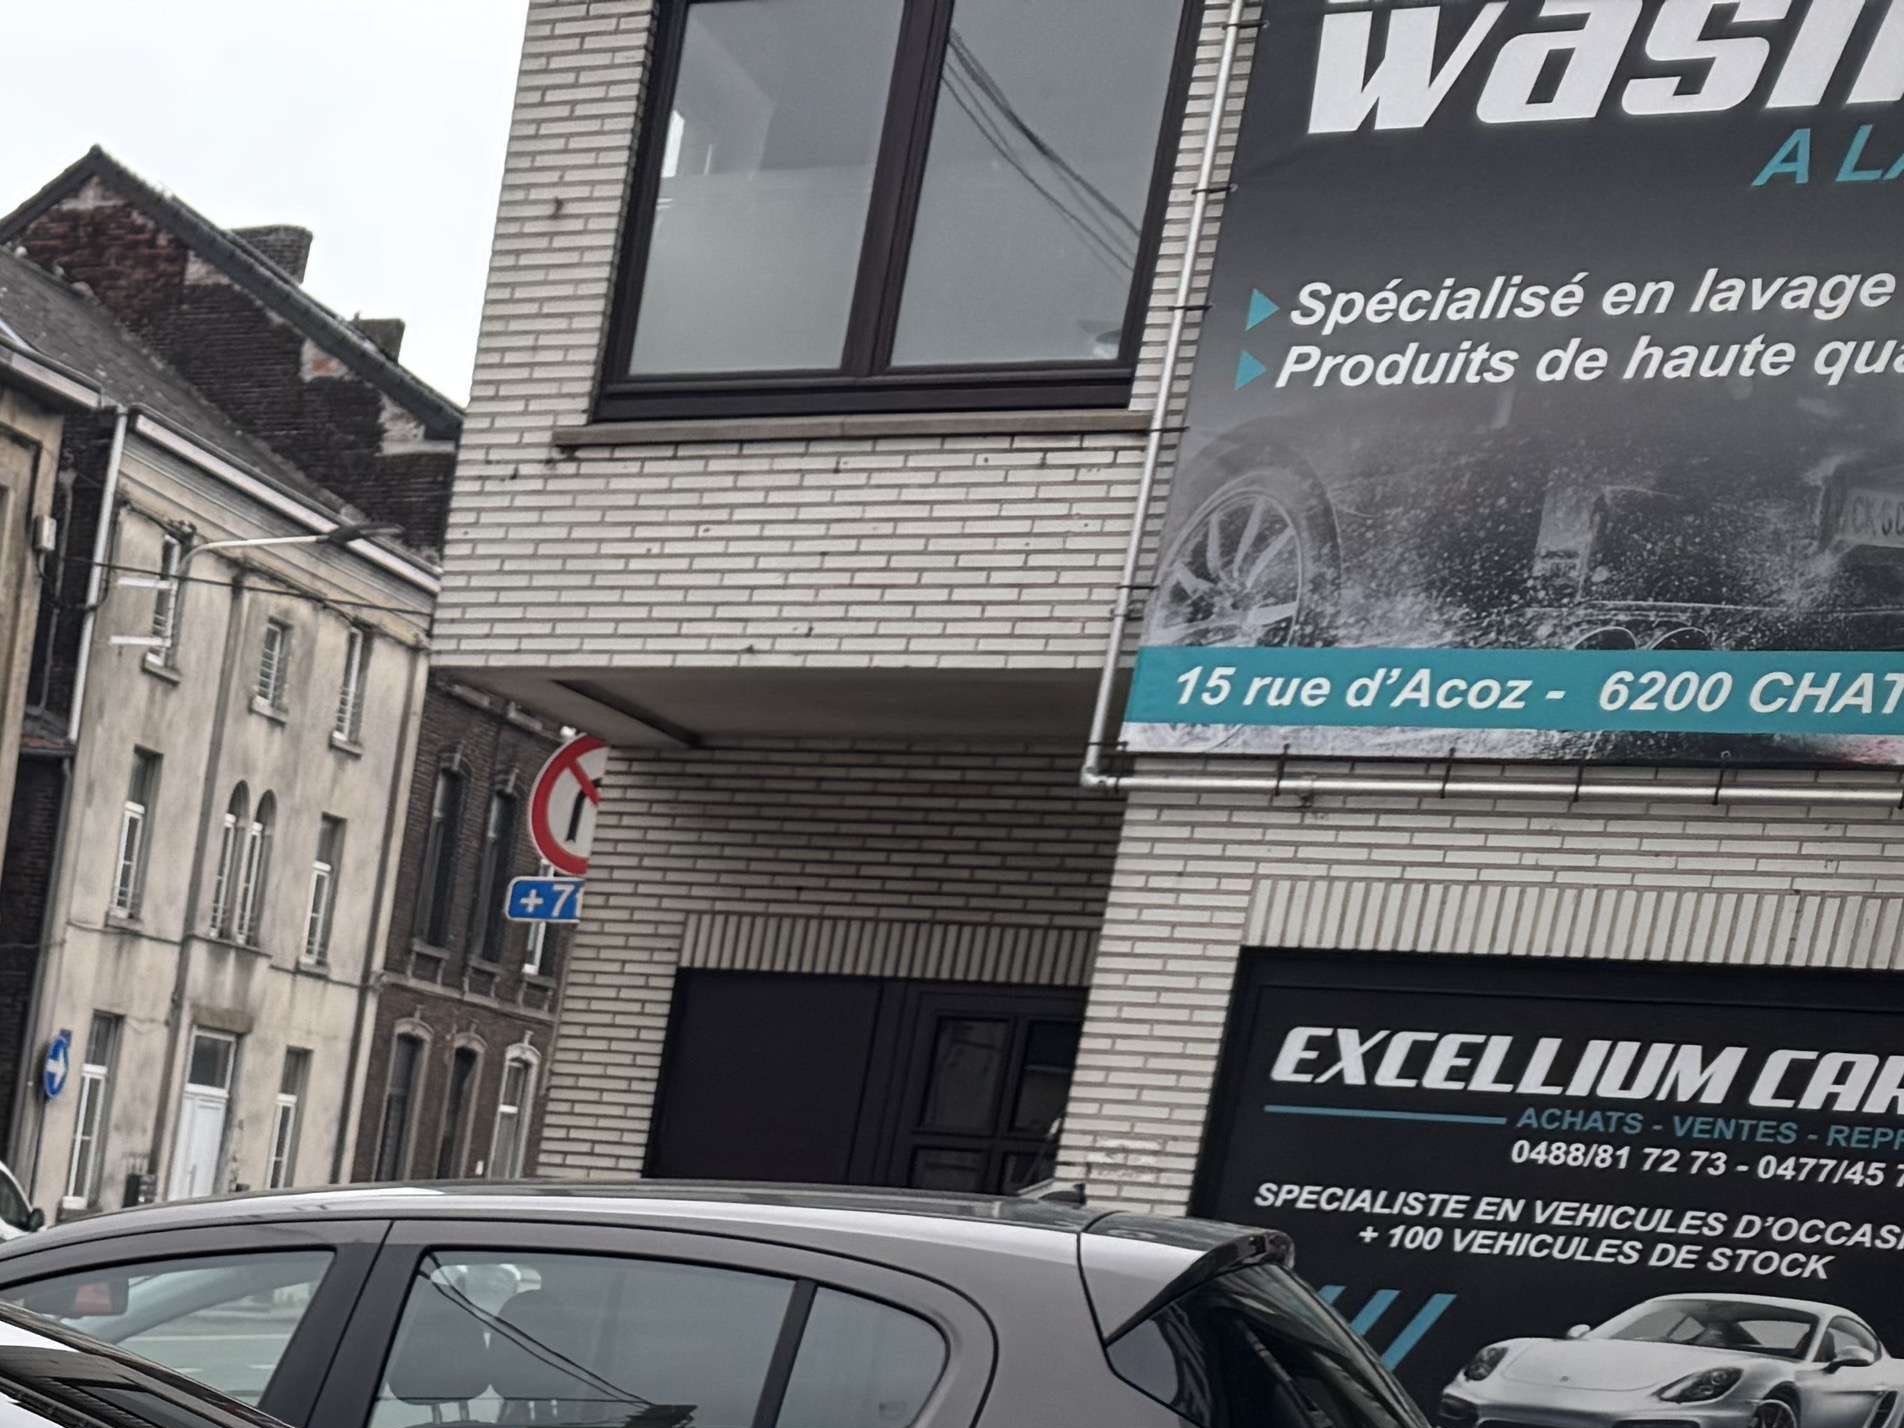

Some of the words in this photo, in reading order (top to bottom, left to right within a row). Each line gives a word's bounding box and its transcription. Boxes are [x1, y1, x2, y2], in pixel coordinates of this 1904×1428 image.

[1751, 127, 1811, 187] A
[1835, 124, 1904, 182] L
[1290, 272, 1589, 336] Spécialisé
[1602, 280, 1675, 316] en
[1689, 267, 1896, 321] lavage
[1275, 340, 1520, 388] Produits
[1535, 337, 1609, 382] de
[1622, 333, 1796, 379] haute
[1176, 665, 1236, 706] 15
[1242, 675, 1331, 708] rue
[1345, 667, 1533, 710] d'Acoz
[1598, 670, 1734, 712] 6200
[551, 884, 583, 918] 7
[1270, 1026, 1748, 1104] EXCELLIUM
[1517, 1107, 1644, 1134] ACHATS
[1673, 1115, 1798, 1143] VENTES
[1511, 1140, 1630, 1169] 0488/81
[1642, 1147, 1681, 1173] 72
[1689, 1150, 1727, 1176] 73
[1757, 1155, 1886, 1186] 0477/45
[1254, 1183, 1471, 1219] SPECIALISTE
[1473, 1197, 1526, 1223] EN
[1534, 1200, 1729, 1237] VEHICULES
[1388, 1224, 1442, 1251] 100
[1453, 1228, 1643, 1265] VEHICULES
[1648, 1242, 1703, 1269] DE
[1707, 1247, 1836, 1280] STOCK
